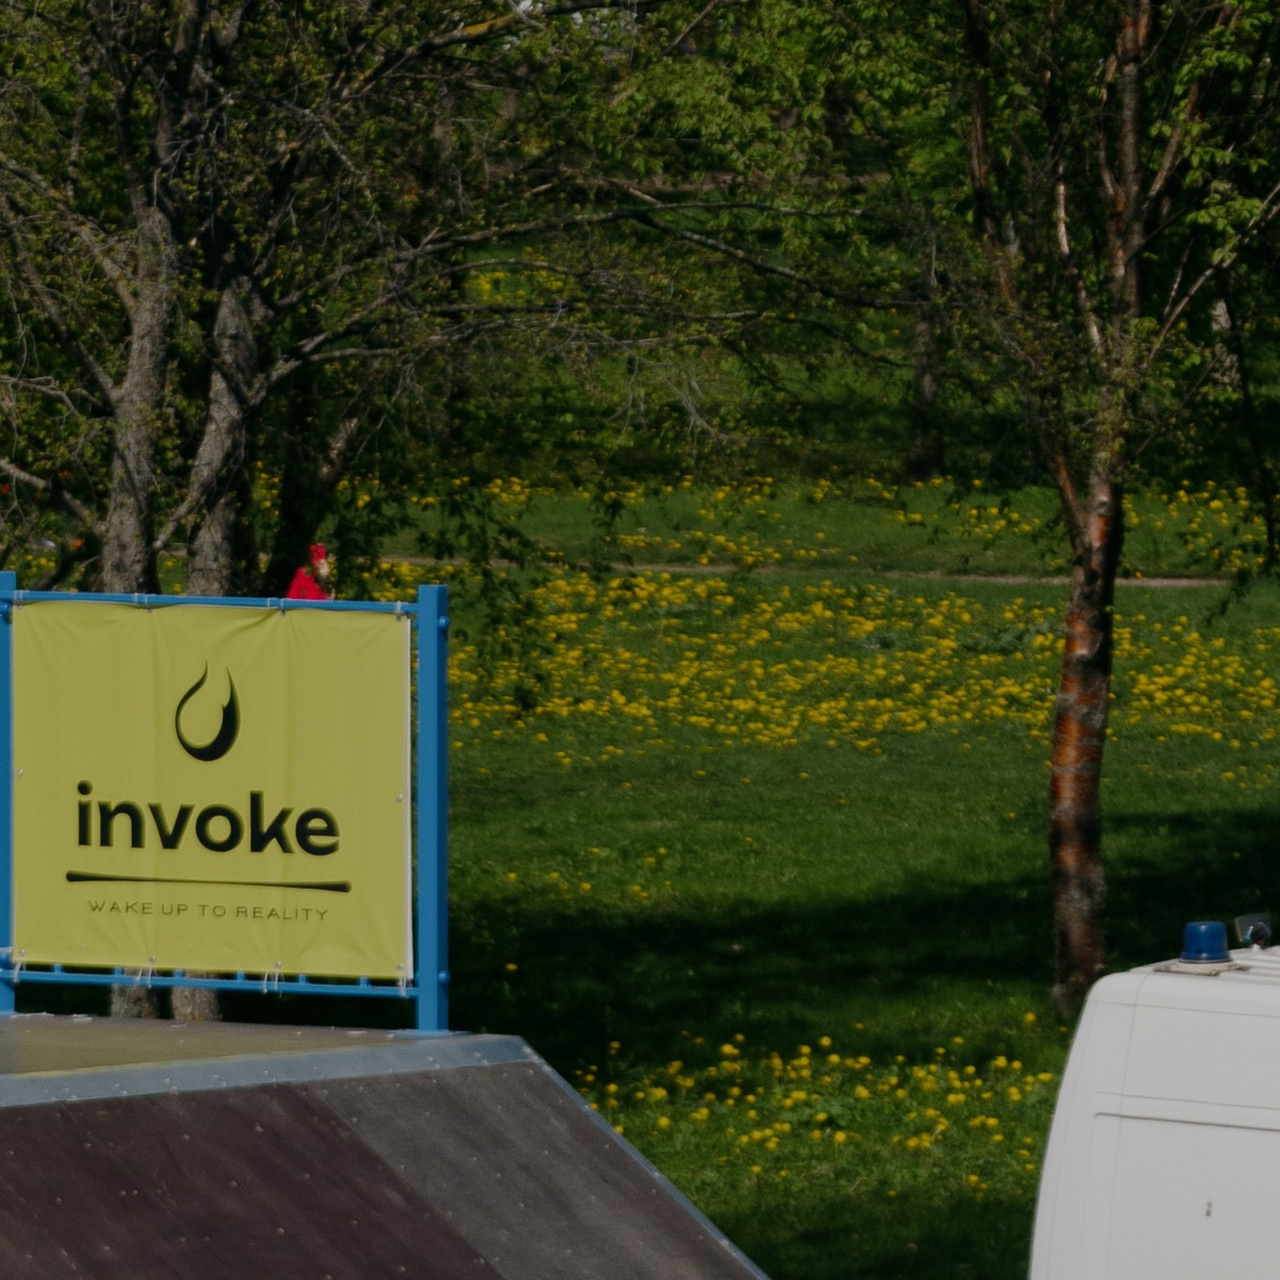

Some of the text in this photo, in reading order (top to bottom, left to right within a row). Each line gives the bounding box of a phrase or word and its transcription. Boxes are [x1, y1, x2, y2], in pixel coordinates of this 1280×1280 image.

[76, 779, 340, 856] invoke
[89, 899, 330, 921] WAKE UP TO REALITY
